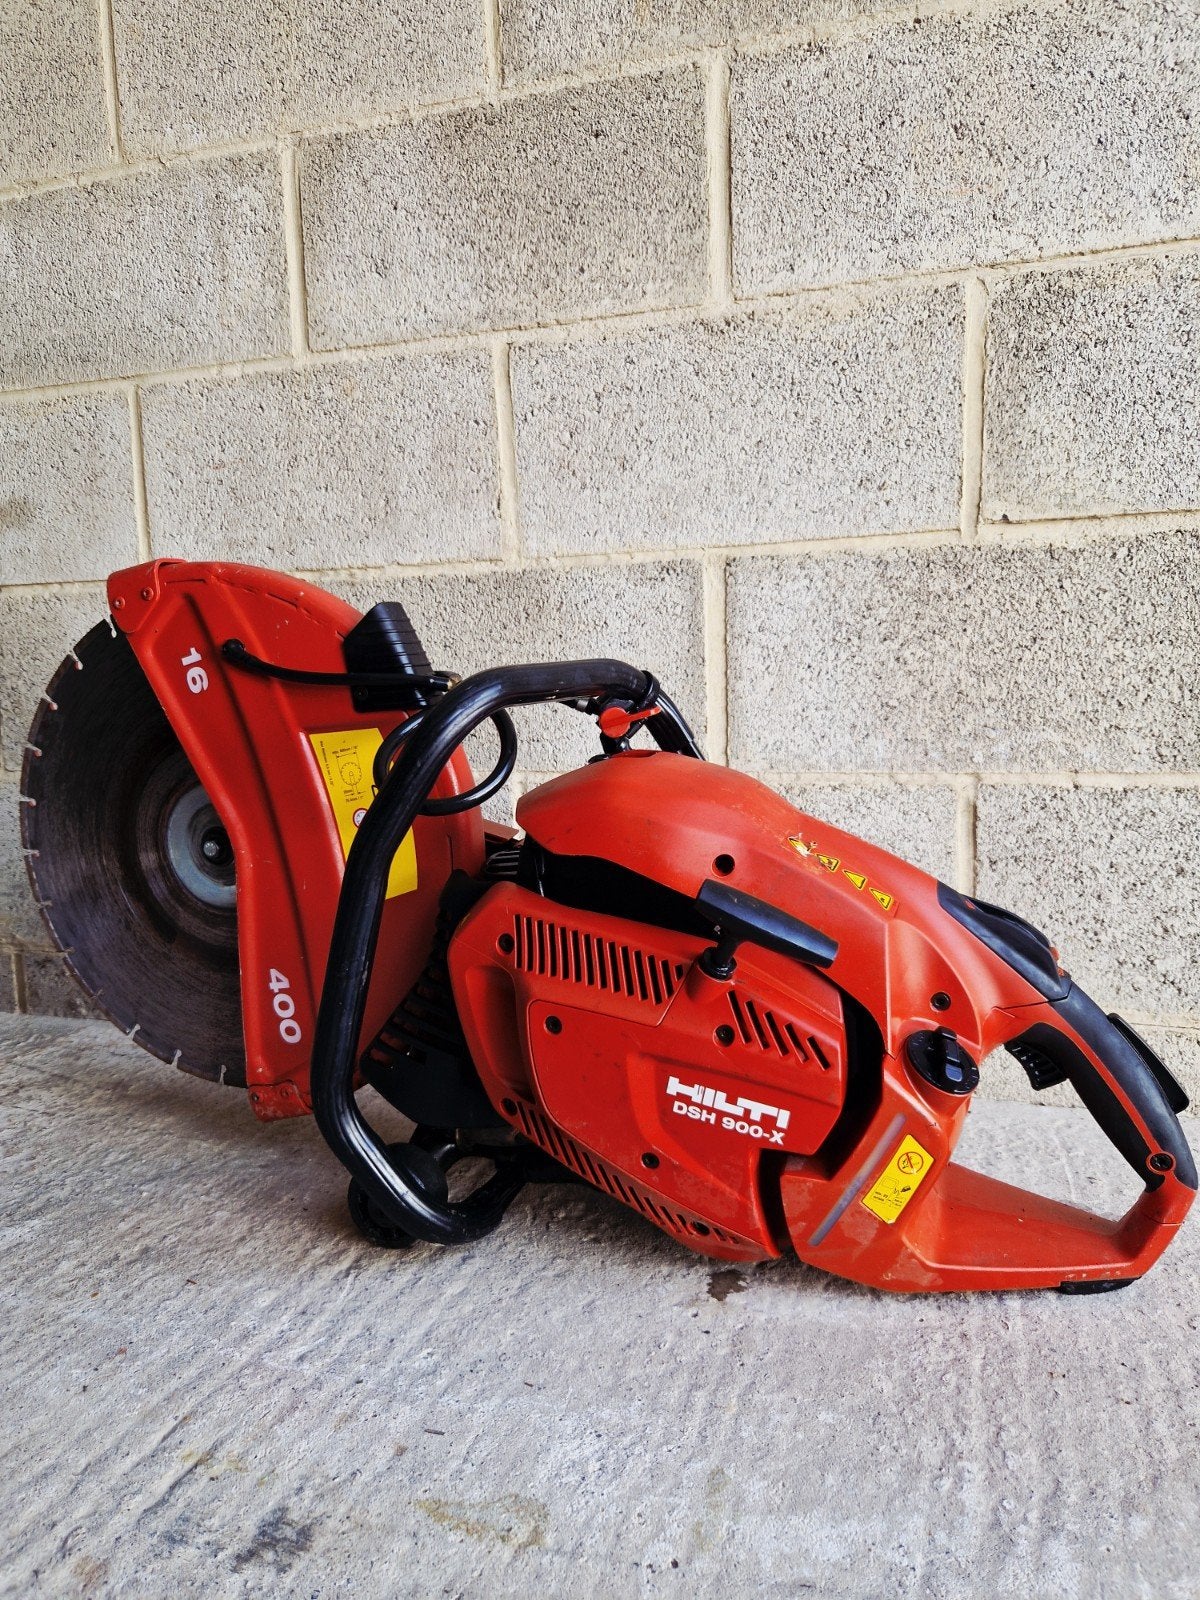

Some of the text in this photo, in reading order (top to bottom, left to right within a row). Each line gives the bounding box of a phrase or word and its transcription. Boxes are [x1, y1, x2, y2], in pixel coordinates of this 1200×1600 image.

[181, 647, 209, 694] 16
[269, 968, 302, 1044] 400
[666, 1075, 791, 1129] HILTI
[672, 1100, 785, 1145] DSH 900-X
